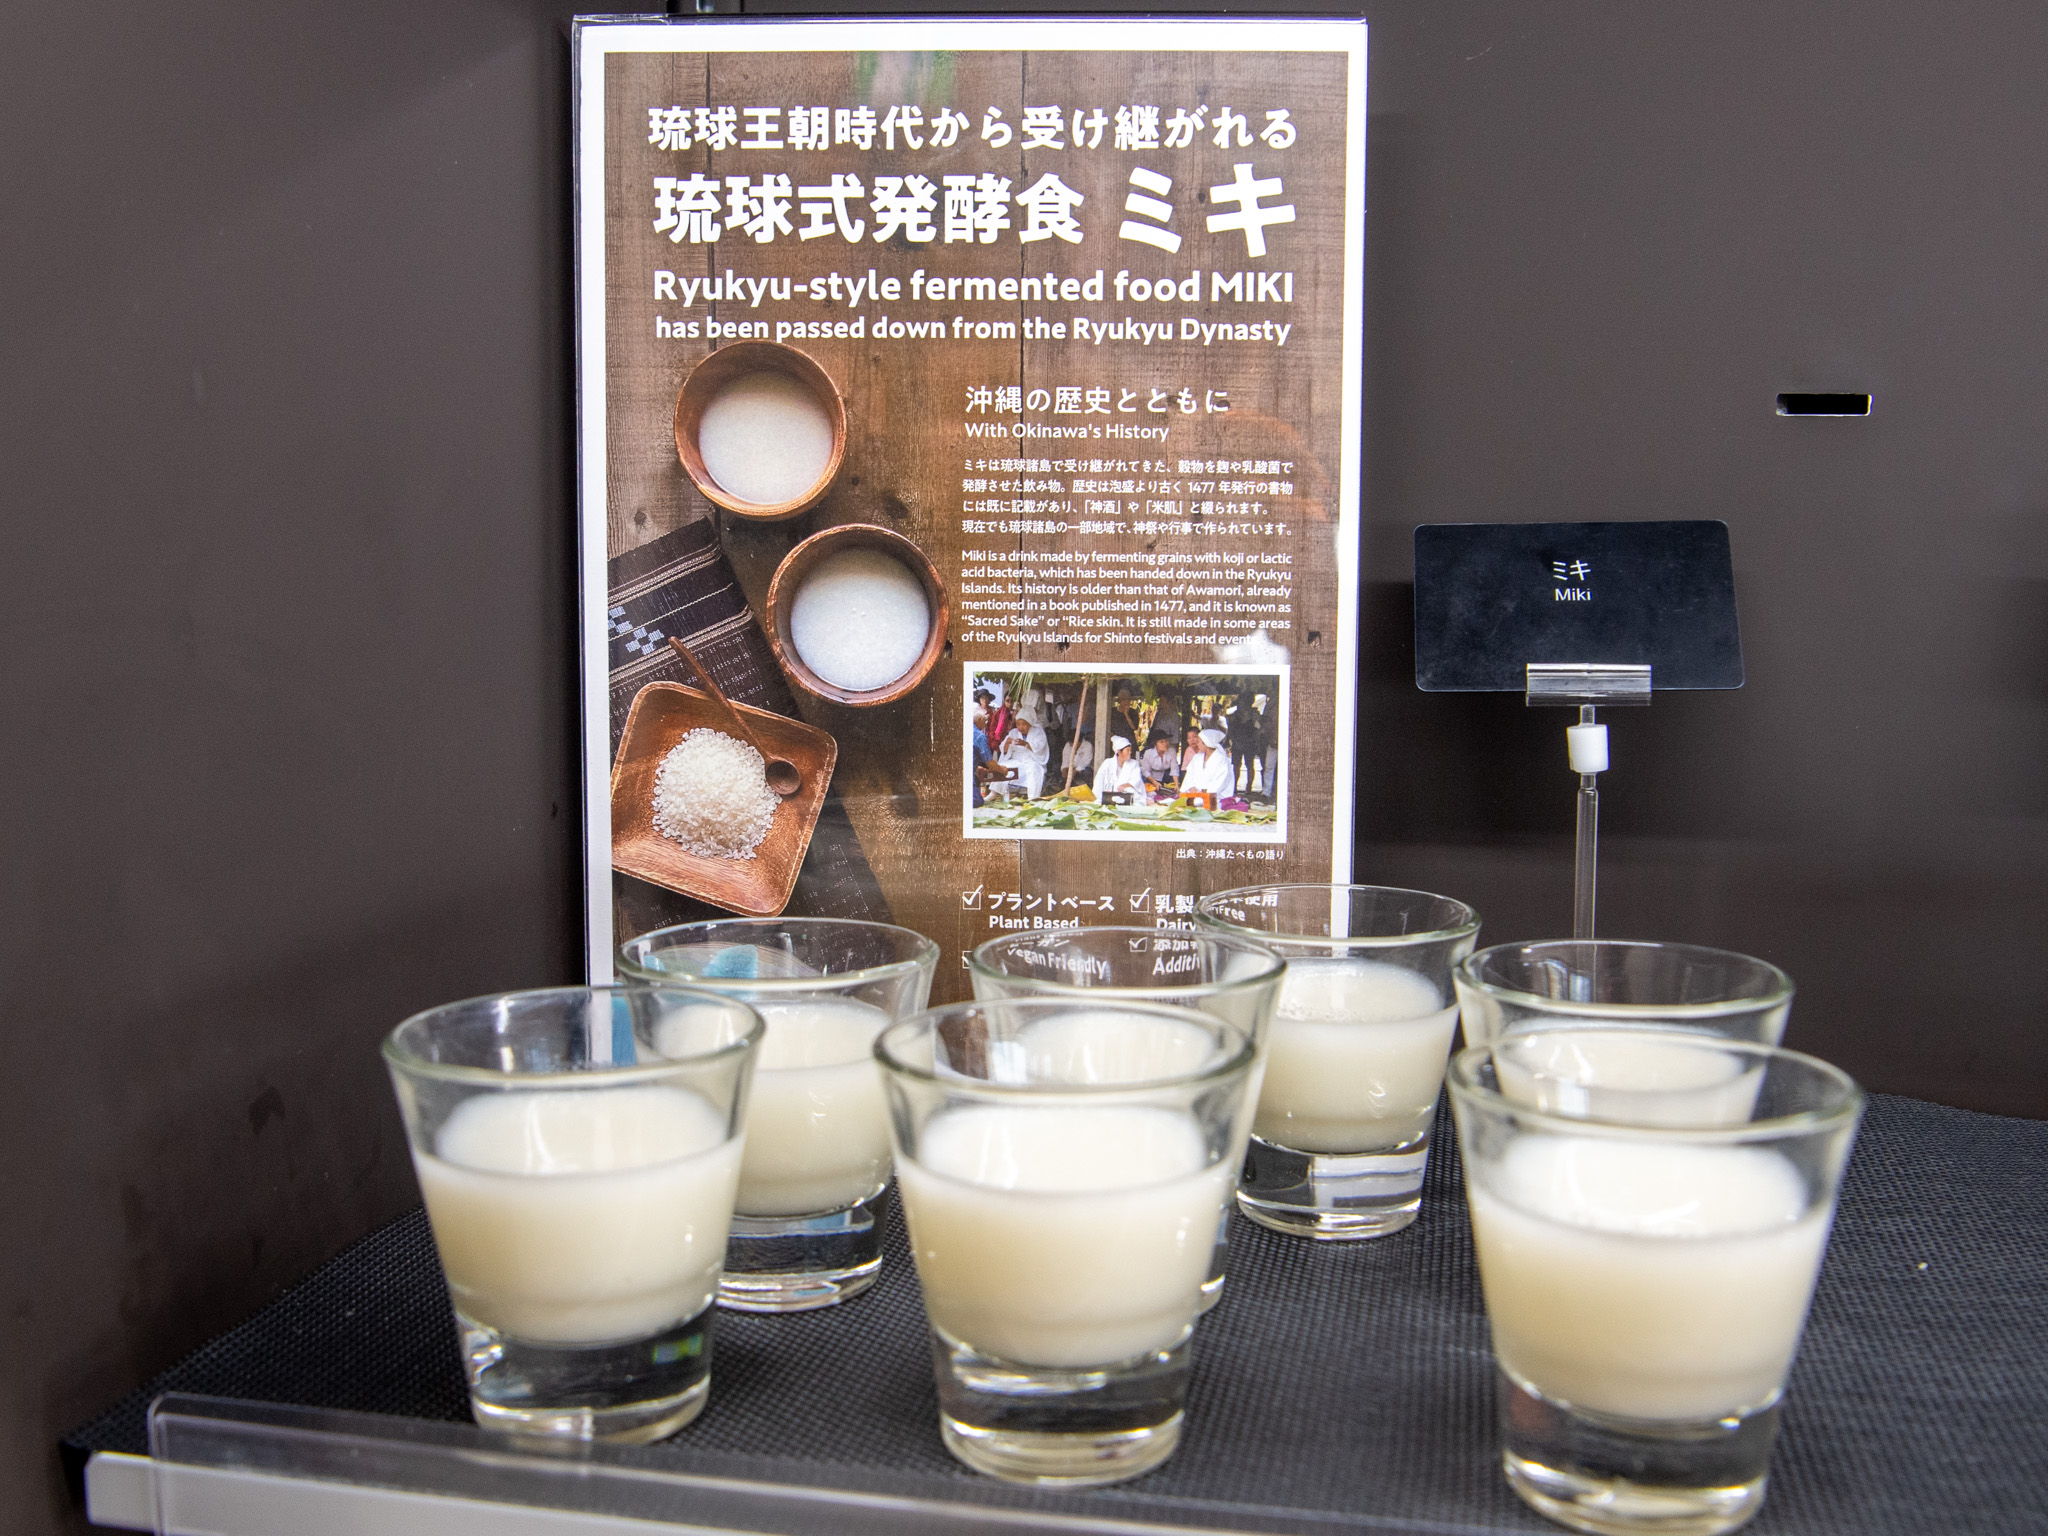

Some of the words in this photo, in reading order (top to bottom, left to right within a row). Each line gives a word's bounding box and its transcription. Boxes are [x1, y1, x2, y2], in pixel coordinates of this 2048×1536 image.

[647, 105, 1298, 152] 琉球王朝時代から受け継がれる
[652, 173, 1085, 244] 琉球式発酵食
[1118, 163, 1296, 258] ミキ
[653, 269, 901, 308] Ryukyu-style
[909, 269, 1104, 301] fermented
[1113, 269, 1201, 302] food
[1211, 271, 1293, 303] MIKI
[655, 315, 700, 339] has
[706, 315, 769, 338] been
[776, 315, 865, 344] passed
[871, 315, 946, 339] down
[952, 316, 1016, 339] from
[1022, 316, 1067, 339] the
[1073, 316, 1173, 346] Ryukyu
[1180, 317, 1292, 346] Dynasty
[965, 382, 1229, 417] 沖縄の歴史とともに
[964, 422, 1008, 438] With
[1012, 422, 1102, 439] Okinawa's
[1106, 423, 1170, 443] History
[961, 549, 986, 562] Miki
[988, 550, 998, 562] is
[999, 552, 1006, 562] a
[1008, 549, 1039, 562] drink
[1040, 550, 1073, 562] made
[1075, 549, 1090, 565] by
[1091, 550, 1157, 566] fermenting
[1157, 551, 1193, 566] grains
[1194, 551, 1221, 564] with
[1223, 551, 1245, 567] koji
[1246, 554, 1260, 564] or
[1261, 551, 1293, 565] lactic
[961, 565, 985, 578] acid
[987, 565, 1037, 580] bacteria,
[1038, 566, 1075, 579] which
[1076, 566, 1097, 579] has
[1099, 566, 1128, 579] been
[1130, 566, 1174, 580] handed
[1175, 567, 1210, 580] down
[1212, 567, 1223, 580] in
[1225, 567, 1245, 580] the
[1247, 567, 1292, 583] Ryukyu
[1553, 560, 1592, 581] ミキ
[961, 581, 1006, 594] Islands.
[1008, 582, 1023, 594] Its
[1024, 582, 1067, 598] history
[1069, 582, 1079, 595] is
[1080, 582, 1113, 595] older
[1114, 582, 1142, 595] than
[1143, 583, 1169, 596] that
[1170, 583, 1185, 596] of
[1186, 583, 1245, 598] Awamori,
[1246, 584, 1292, 600] already
[1554, 588, 1592, 602] Miki
[961, 598, 1025, 611] mentioned
[1026, 598, 1038, 611] in
[1040, 601, 1047, 611] a
[1049, 598, 1080, 611] book
[1081, 598, 1139, 614] published
[1141, 599, 1152, 612] in
[1154, 599, 1187, 614] 1477,
[1188, 599, 1211, 613] and
[1213, 600, 1222, 613] it
[1224, 600, 1234, 613] is
[1235, 600, 1276, 613] known
[1278, 603, 1292, 613] as
[1047, 617, 1060, 627] or
[1096, 615, 1124, 628] skin.
[1126, 615, 1135, 628] It
[1137, 615, 1147, 628] is
[1149, 615, 1172, 628] still
[1174, 616, 1208, 629] made
[1210, 616, 1221, 629] in
[1223, 619, 1256, 629] some
[1258, 620, 1291, 630] areas
[961, 630, 975, 642] of
[975, 630, 996, 642] the
[997, 630, 1041, 646] Ryukyu
[1043, 631, 1083, 643] Islands
[1084, 631, 1103, 644] for
[1104, 631, 1143, 644] Shinto
[1144, 631, 1193, 645] festivals
[1194, 633, 1216, 645] and
[1176, 848, 1284, 861] 出典：沖縄たべもの語り
[988, 891, 1115, 912] プラントベース
[989, 915, 1030, 929] Plant
[1033, 916, 1079, 929] Based
[1047, 951, 1108, 980] Friendly
